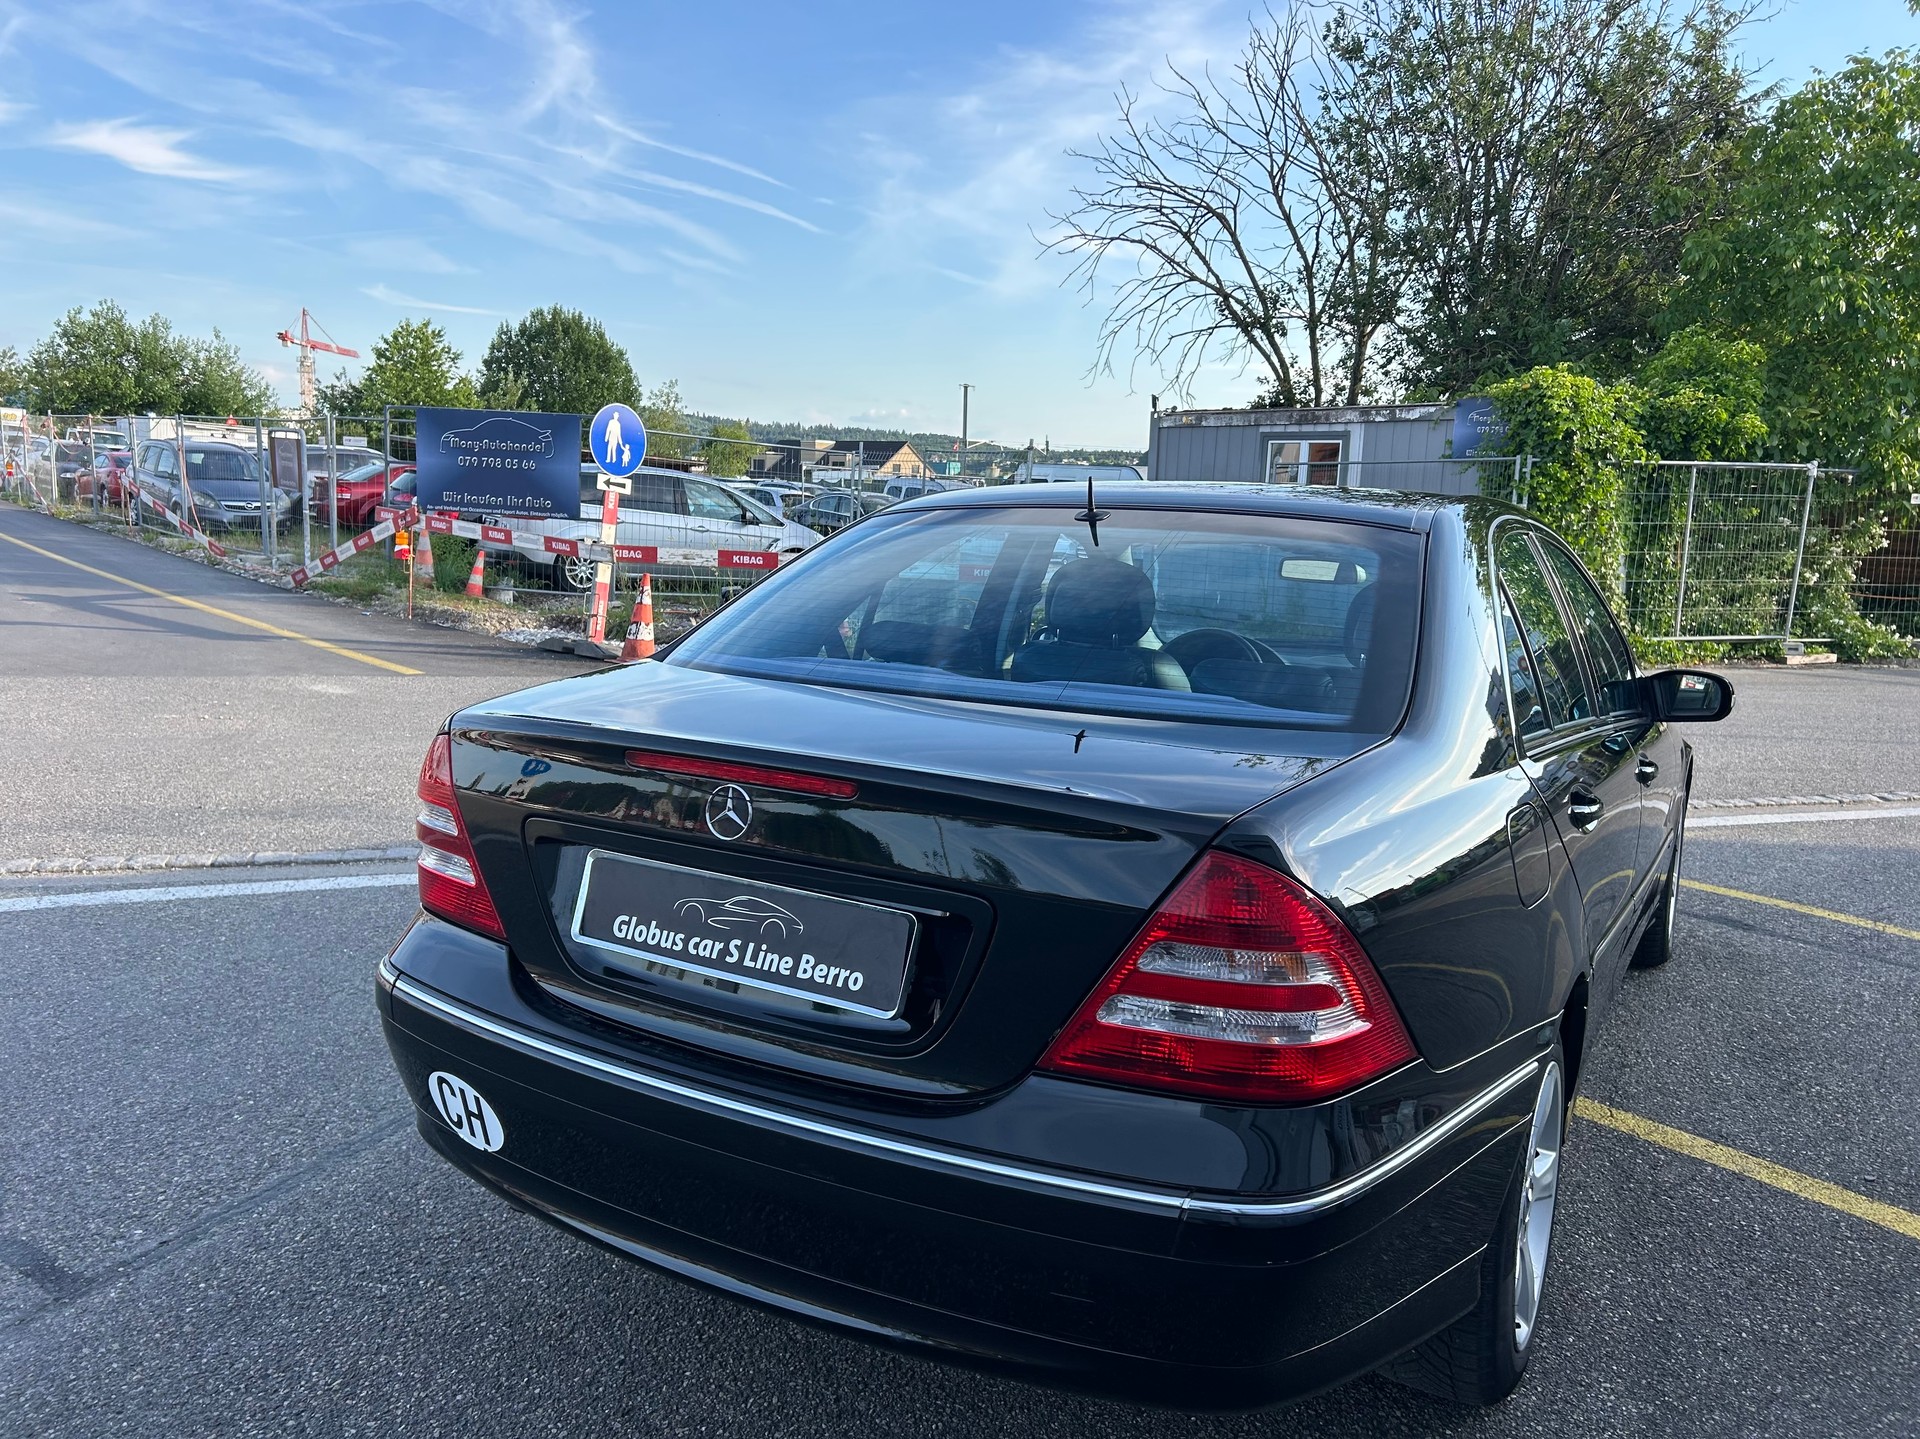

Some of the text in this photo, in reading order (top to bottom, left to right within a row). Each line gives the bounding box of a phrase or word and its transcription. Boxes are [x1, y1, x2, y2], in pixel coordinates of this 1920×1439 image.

[450, 437, 545, 453] Mony-Autohandel
[457, 455, 536, 470] 079 798 05 66
[443, 491, 552, 508] Wir kaufen Ihr Auto
[431, 519, 447, 530] KIBAG
[488, 530, 505, 540] KIBAG
[552, 541, 571, 552] KIBAG
[613, 549, 643, 559] KIBAG
[732, 555, 764, 565] KIBAG
[612, 914, 864, 991] Globus car S Line Berro
[436, 1075, 491, 1147] CH
